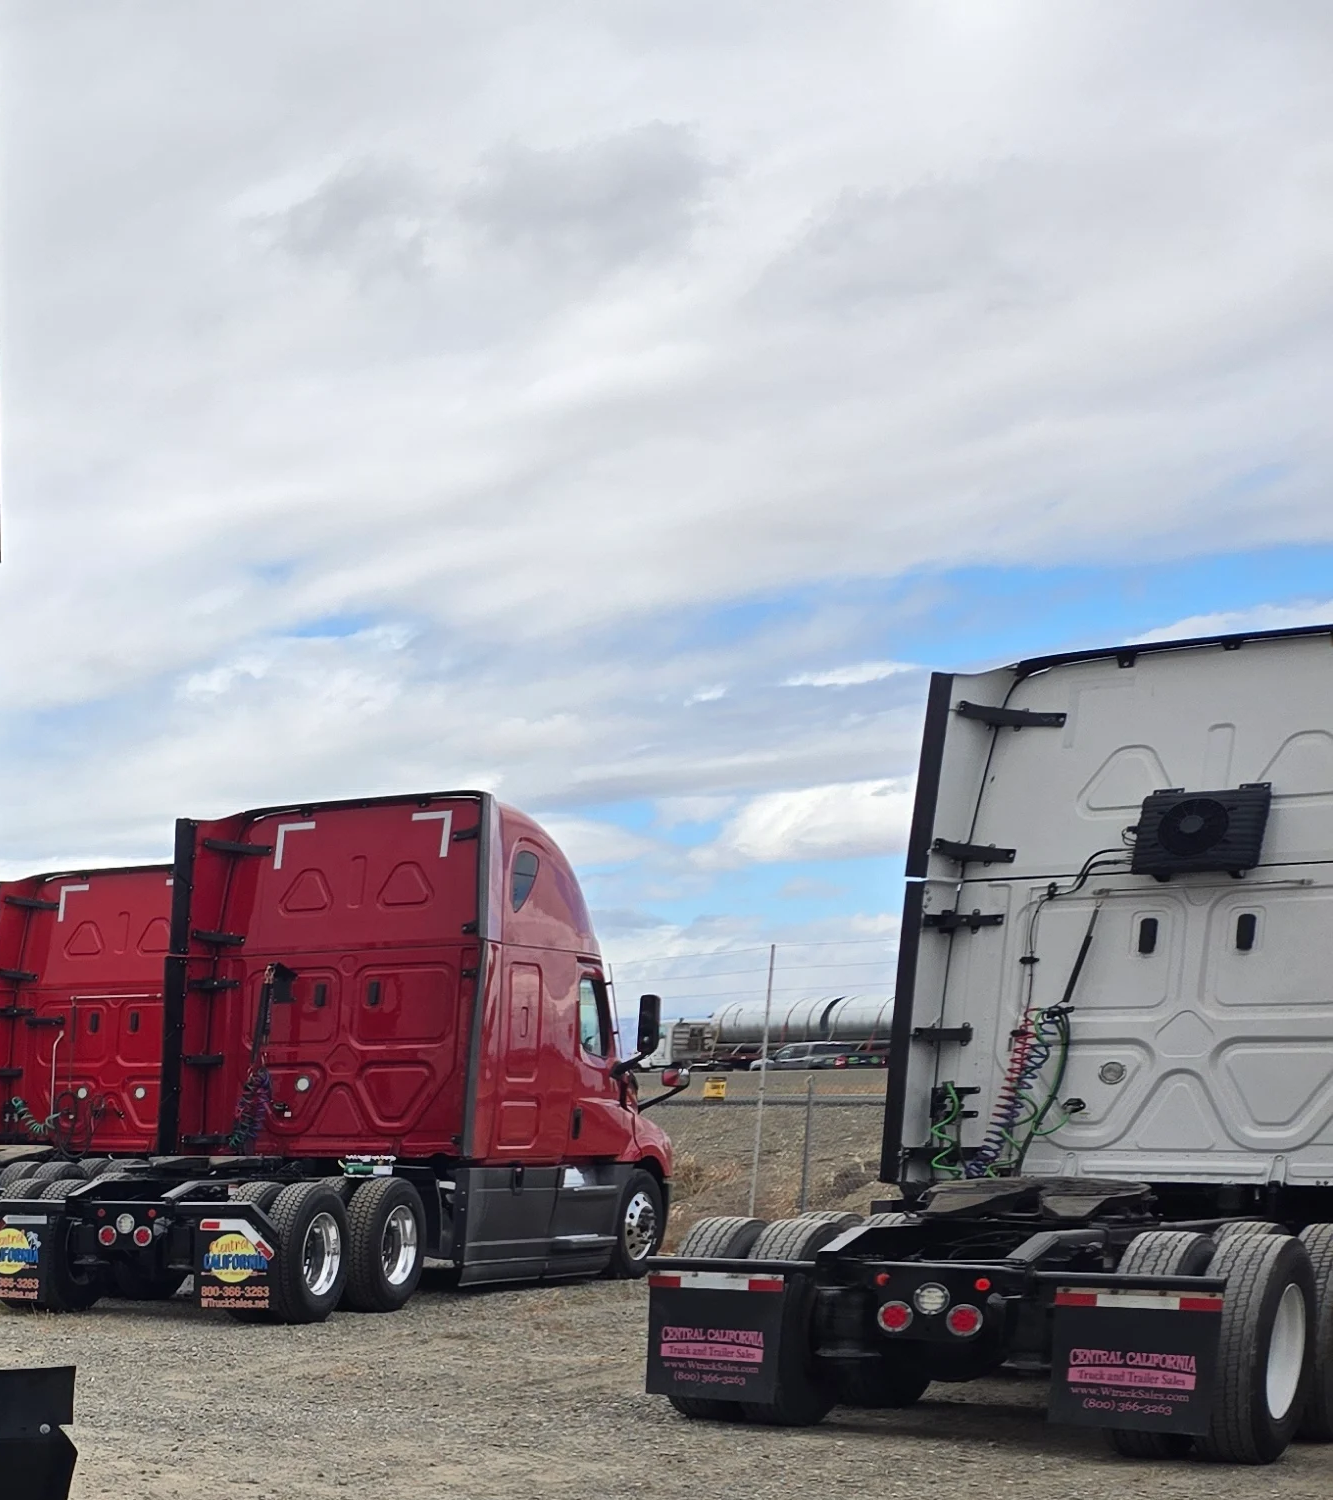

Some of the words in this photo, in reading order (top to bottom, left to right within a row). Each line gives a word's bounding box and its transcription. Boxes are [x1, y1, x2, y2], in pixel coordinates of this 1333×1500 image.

[203, 1253, 268, 1270] CALIFORNIA
[201, 1285, 270, 1297] 800-366-3263
[201, 1298, 270, 1309] WTruckSales.net
[661, 1326, 706, 1341] CENTRAL
[707, 1329, 764, 1347] CALIFORNIA
[668, 1345, 690, 1355] Truck
[692, 1346, 707, 1356] and
[709, 1347, 735, 1358] Trailer
[736, 1348, 756, 1359] Sales
[1070, 1348, 1125, 1366] CENTRAL
[1126, 1352, 1197, 1373] CALIFORNIA
[673, 1371, 700, 1382] (800)
[701, 1373, 746, 1386] 366-3263
[1077, 1369, 1105, 1380] Truck
[1106, 1371, 1125, 1381] and
[1128, 1372, 1160, 1384] Trailer
[1161, 1374, 1186, 1386] Sales
[1082, 1398, 1116, 1411] (800)
[1117, 1401, 1173, 1416] 366-3263
